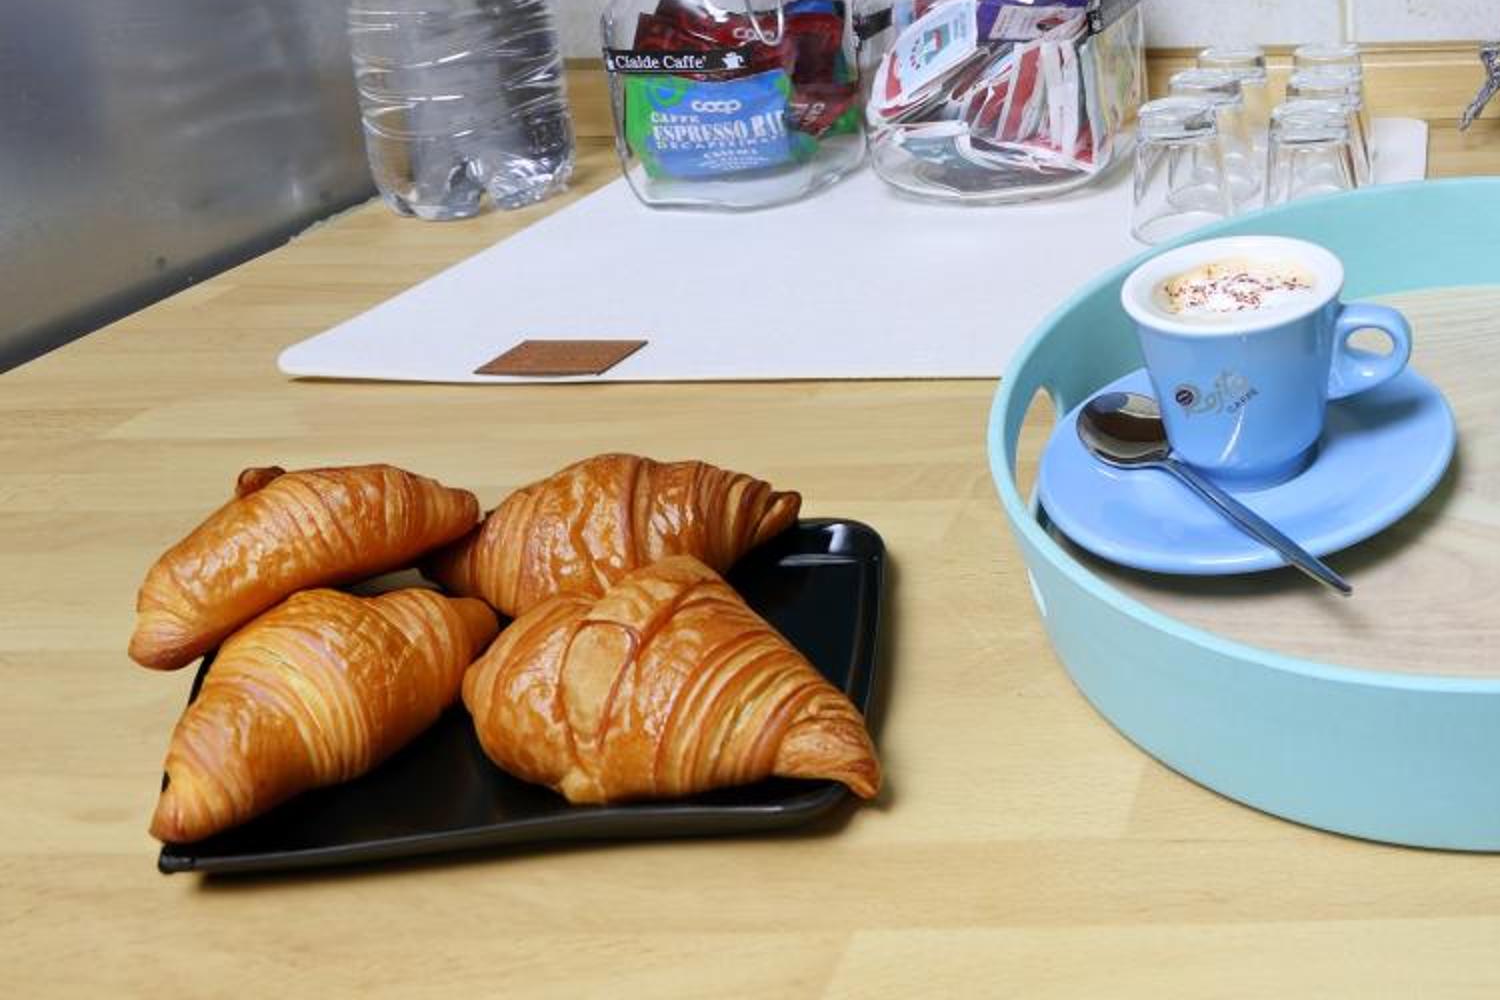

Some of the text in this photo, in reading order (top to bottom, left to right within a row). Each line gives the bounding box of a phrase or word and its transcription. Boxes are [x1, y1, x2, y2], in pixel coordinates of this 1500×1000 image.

[614, 55, 659, 69] Cialde
[691, 99, 742, 114] coop
[652, 119, 748, 143] ESPRESSO
